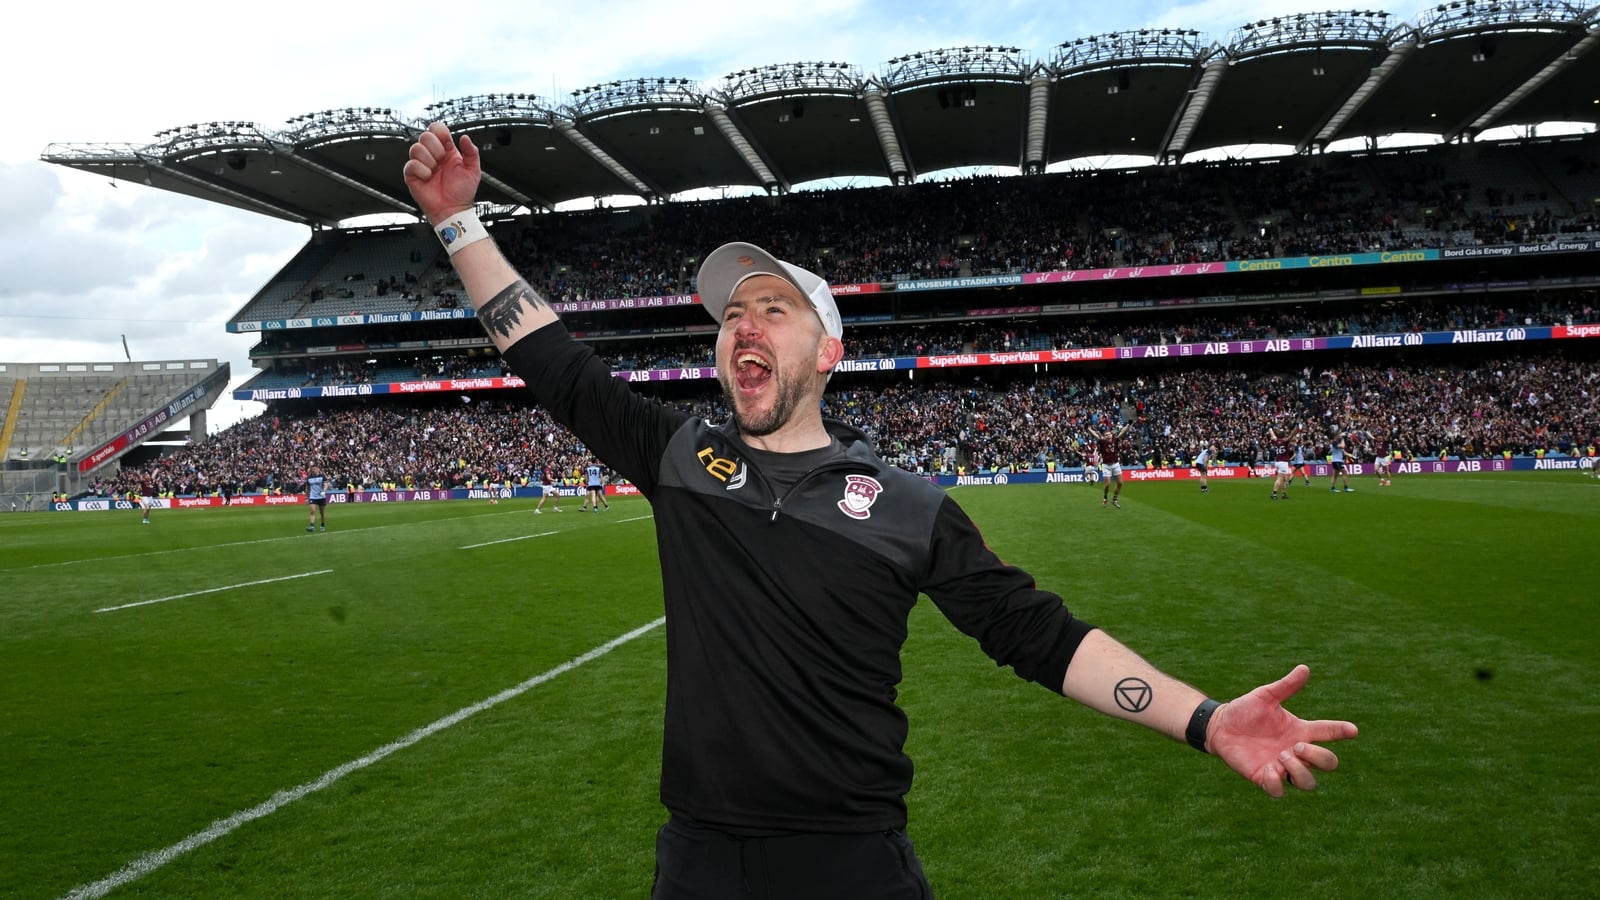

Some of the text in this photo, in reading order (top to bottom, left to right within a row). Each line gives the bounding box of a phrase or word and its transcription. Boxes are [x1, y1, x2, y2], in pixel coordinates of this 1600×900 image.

[1484, 246, 1512, 255] Energy
[1560, 242, 1588, 250] Energy
[1309, 256, 1352, 268] Centra
[1381, 252, 1424, 262] Centra
[1240, 260, 1281, 271] Centra
[898, 282, 916, 290] GAA
[917, 280, 952, 288] MUSEUM
[960, 277, 996, 286] STADIUM
[998, 276, 1022, 284] TOUR
[830, 285, 860, 294] uperValu
[620, 300, 634, 308] AIB
[648, 298, 663, 306] AIB
[676, 296, 692, 304] AIB
[562, 304, 578, 312] AIB
[591, 302, 606, 310] AIB
[368, 314, 398, 324] Allianz
[421, 310, 452, 320] Allianz
[1352, 336, 1401, 348] Allianz
[1452, 331, 1504, 344] Allianz
[1204, 343, 1228, 354] AIB
[1265, 340, 1290, 352] AIB
[1052, 348, 1102, 361] SuperValu
[1144, 346, 1168, 358] AIB
[929, 356, 977, 368] SuperValu
[990, 351, 1040, 364] SuperValu
[835, 360, 877, 372] Allianz
[629, 371, 650, 382] AIB
[680, 368, 700, 379] AIB
[400, 381, 440, 392] SuperValu
[451, 378, 492, 390] SuperValu
[252, 390, 286, 400] Allianz
[322, 386, 357, 396] Allianz
[169, 393, 195, 416] Allianz
[154, 412, 166, 426] AIB
[135, 424, 148, 439] AIB
[1398, 462, 1422, 473] AIB
[1457, 460, 1481, 472] AIB
[1534, 460, 1577, 470] Allianz
[588, 468, 597, 476] 14
[1130, 470, 1174, 480] SuperValu
[1190, 468, 1234, 477] SuerValu
[956, 476, 992, 486] Allianz
[1046, 473, 1082, 483] Allianz
[265, 496, 298, 504] SuperValu
[329, 494, 346, 502] AIB
[371, 492, 388, 502] AIB
[414, 491, 430, 500] AIB
[179, 498, 210, 506] SuperValu
